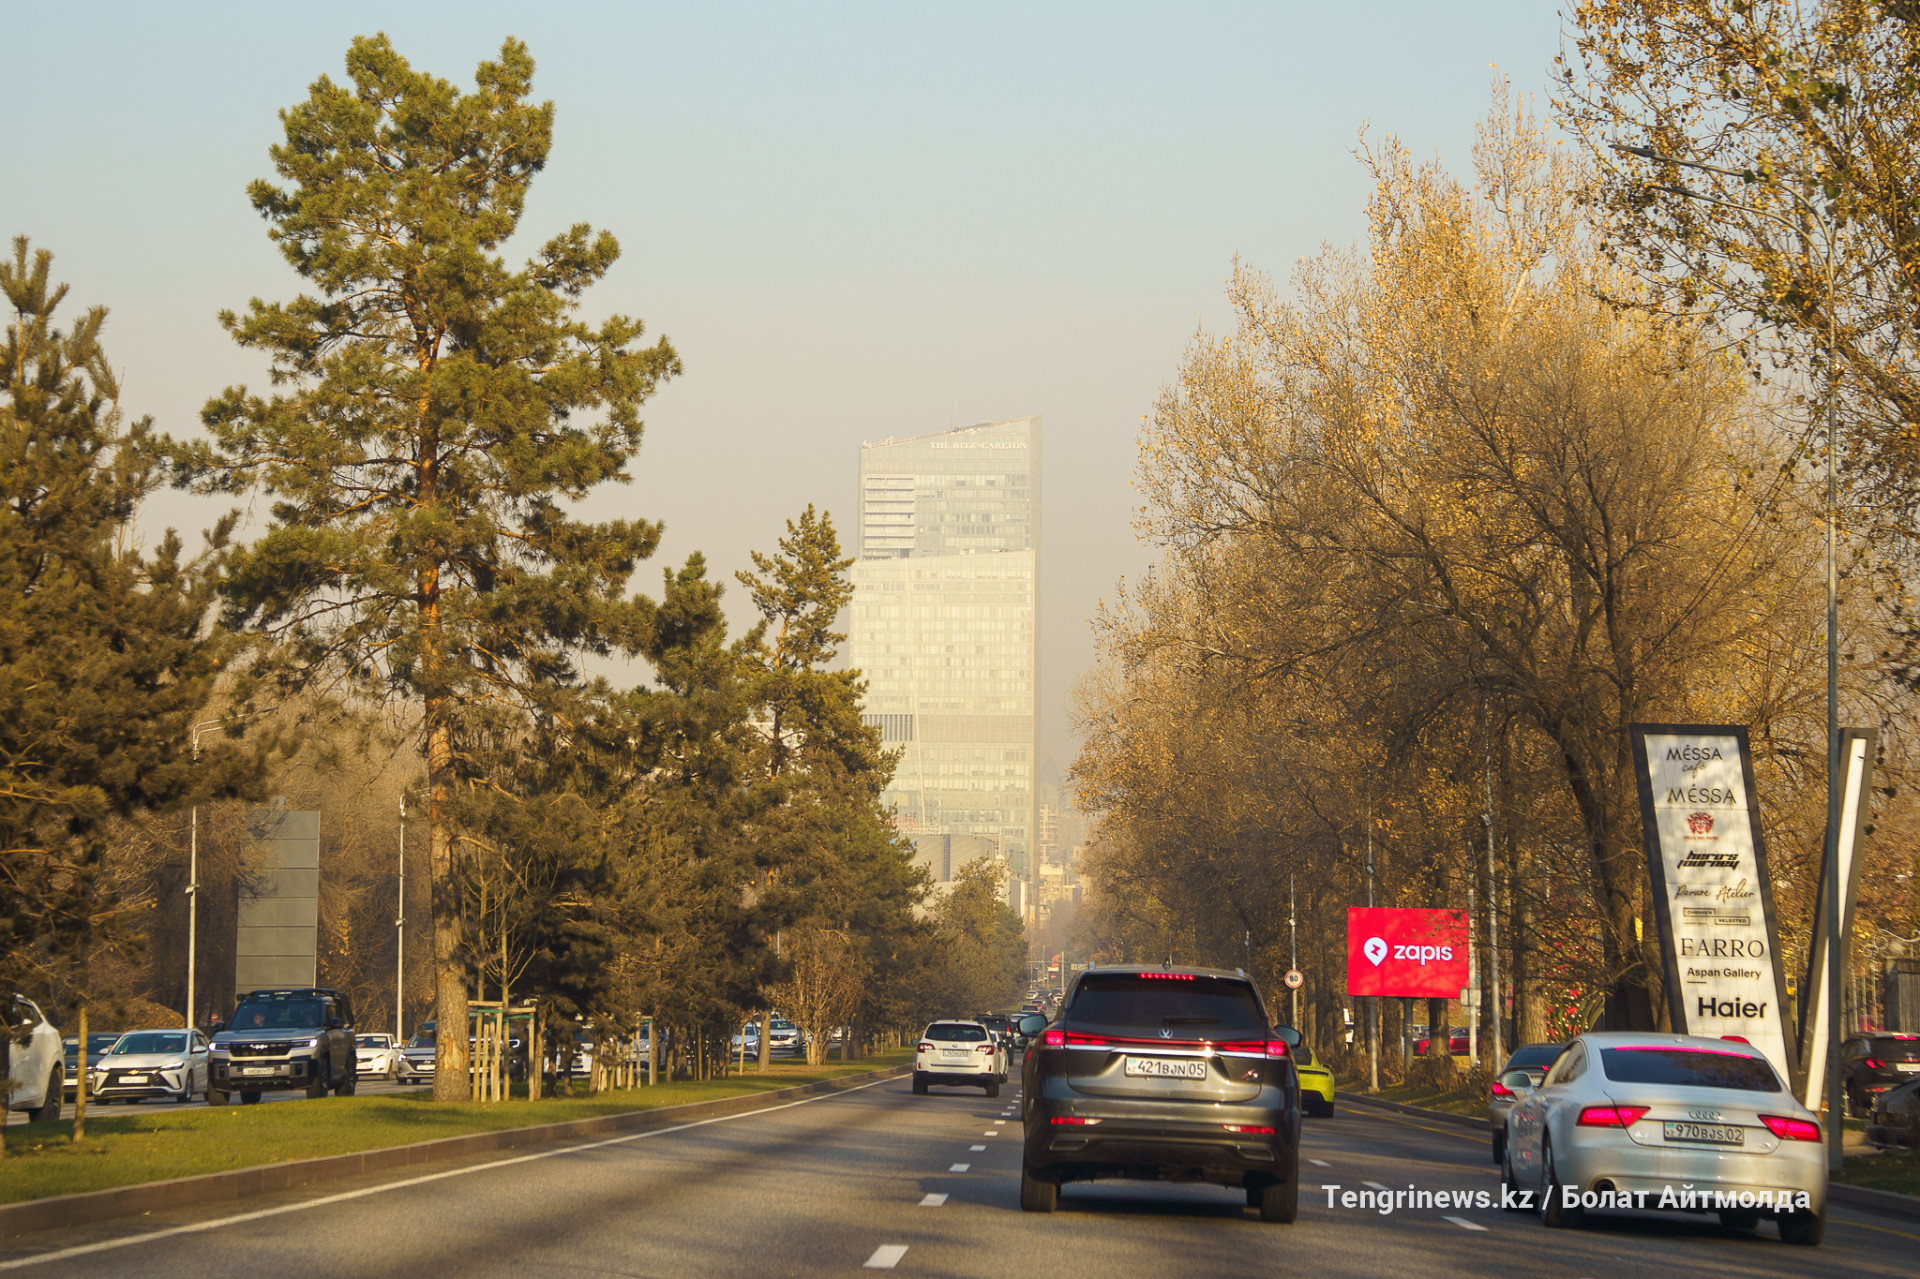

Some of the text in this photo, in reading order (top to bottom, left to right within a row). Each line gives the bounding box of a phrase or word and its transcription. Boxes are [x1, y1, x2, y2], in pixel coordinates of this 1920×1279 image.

[1715, 878, 1755, 904] Atelier
[1393, 945, 1453, 966] zapis
[1681, 938, 1764, 958] FARRO
[1289, 974, 1299, 982] 80
[1687, 967, 1762, 980] Aspan Gallery
[1698, 996, 1767, 1018] Haier
